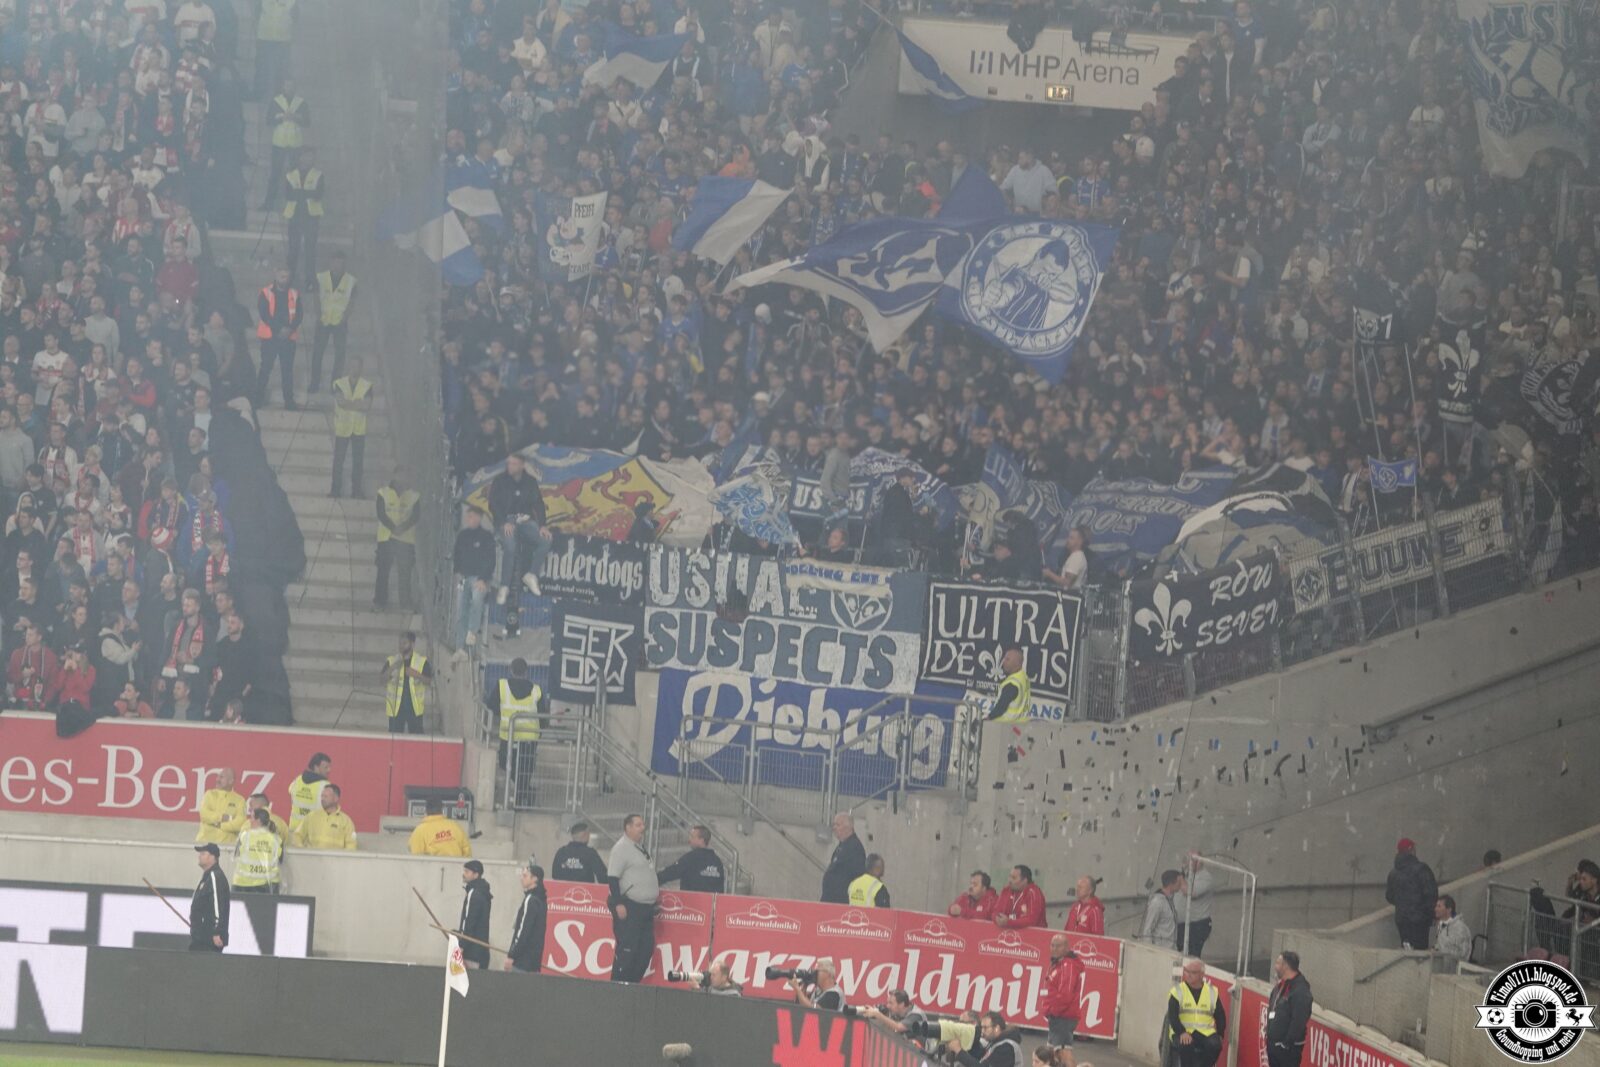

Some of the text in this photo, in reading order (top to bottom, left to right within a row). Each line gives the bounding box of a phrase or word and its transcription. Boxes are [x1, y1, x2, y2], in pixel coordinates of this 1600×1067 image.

[540, 537, 644, 600] nderdogs
[1209, 559, 1273, 606] ROW
[648, 610, 898, 690] SUSPECTS
[930, 640, 1069, 689] DE LIS
[668, 672, 945, 780] Dieburg
[1028, 702, 1064, 721] ANS
[547, 902, 611, 916] chwarzwaldmilc
[727, 915, 799, 932] Schwarzwaldmilch
[818, 923, 891, 940] Schwarzwaldmilch
[905, 933, 965, 950] Schwarzwaldmilch
[979, 942, 1039, 960] Schwarzwaldmilch
[547, 919, 1103, 1029] Scwarzwaldmilh
